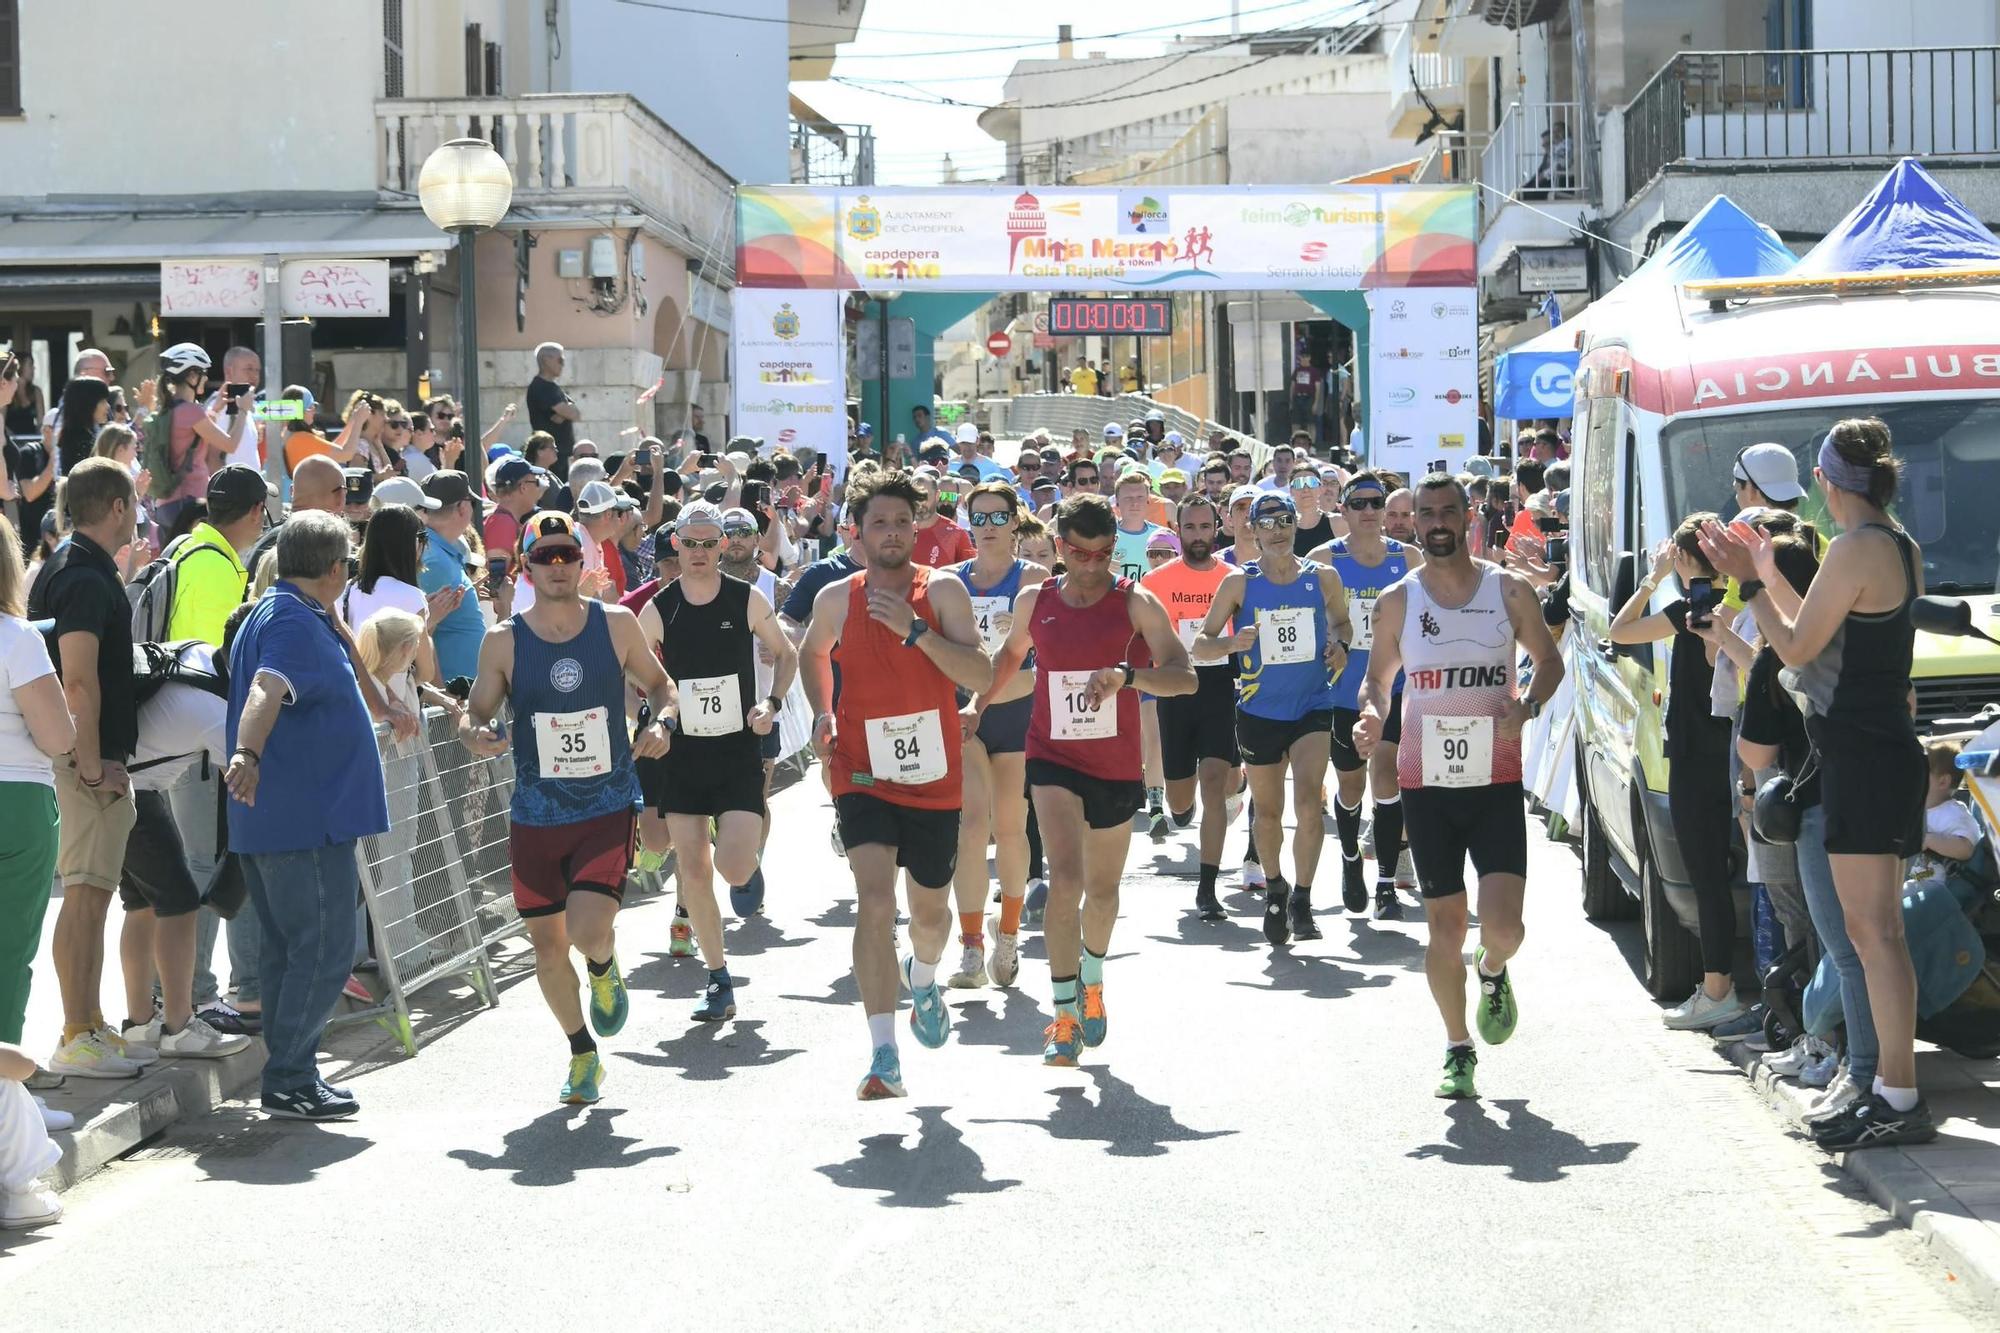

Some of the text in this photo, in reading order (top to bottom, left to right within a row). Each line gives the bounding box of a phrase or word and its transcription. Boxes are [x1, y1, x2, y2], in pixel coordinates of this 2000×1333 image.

[1128, 210, 1167, 219] Mallorca
[865, 249, 939, 260] capdepera
[1023, 263, 1126, 279] Cala Rajada
[1267, 263, 1362, 278] Serrano Hotels
[759, 360, 813, 369] capdepera
[1278, 626, 1296, 643] 88
[1409, 666, 1507, 691] TRITONS
[700, 696, 721, 715] 78
[561, 733, 586, 753] 35
[894, 736, 920, 760] 84
[1444, 739, 1468, 760] 90
